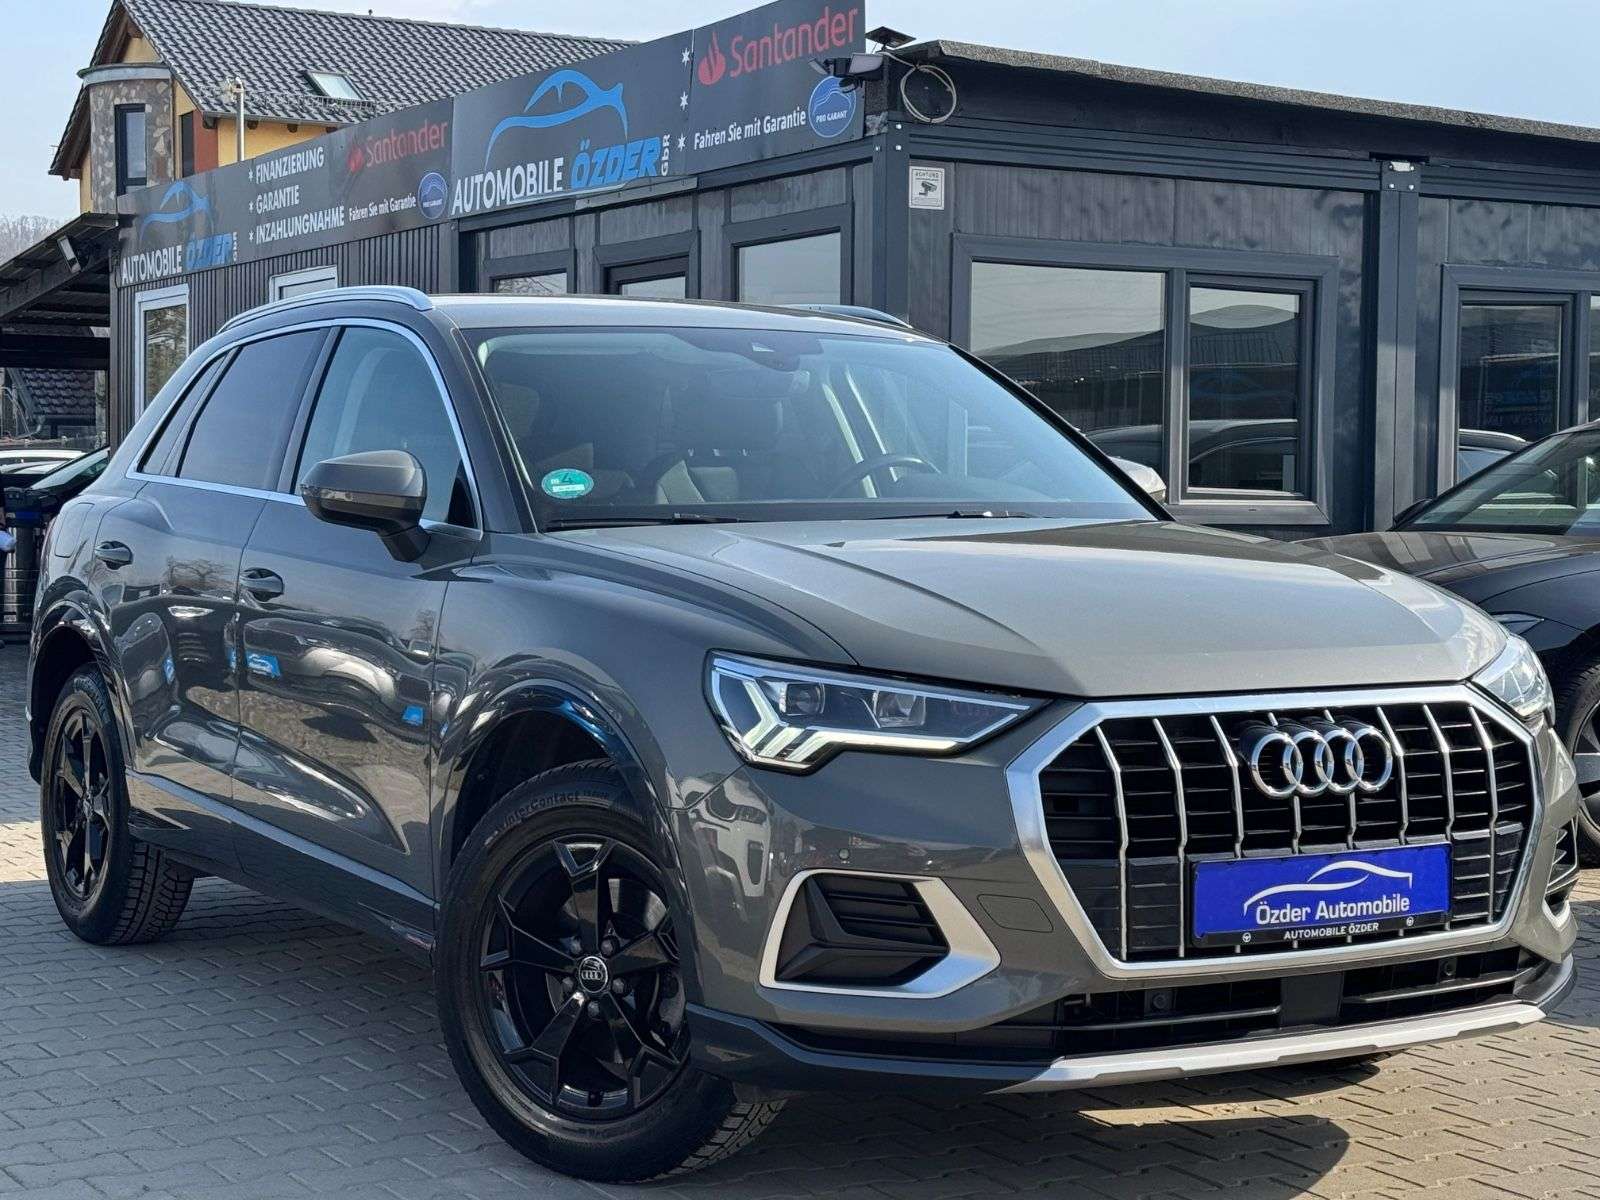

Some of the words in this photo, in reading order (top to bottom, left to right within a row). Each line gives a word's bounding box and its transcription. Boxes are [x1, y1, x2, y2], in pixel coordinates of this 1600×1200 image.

[730, 6, 858, 78] Santander
[366, 119, 448, 167] Santander
[694, 130, 730, 150] Fahren
[728, 122, 742, 142] Sie
[744, 118, 761, 139] mit
[763, 106, 806, 134] Garantie
[256, 147, 324, 184] FINANZIERUNG
[452, 157, 564, 215] AUTOMOBILE
[571, 138, 661, 189] ÖZDER
[661, 134, 671, 176] GbR
[256, 185, 299, 214] GARANTIE
[349, 206, 368, 221] Fahren
[368, 201, 378, 217] Sie
[379, 198, 389, 214] mit
[389, 193, 416, 212] Garantie
[256, 206, 345, 244] INZAHLUNGNAHME
[121, 245, 182, 285] AUTOMOBILE
[1256, 901, 1311, 925] Özder
[1315, 893, 1411, 921] Automobile
[1284, 926, 1346, 941] AUTOMOBILE
[1348, 922, 1379, 935] ÖZDER
